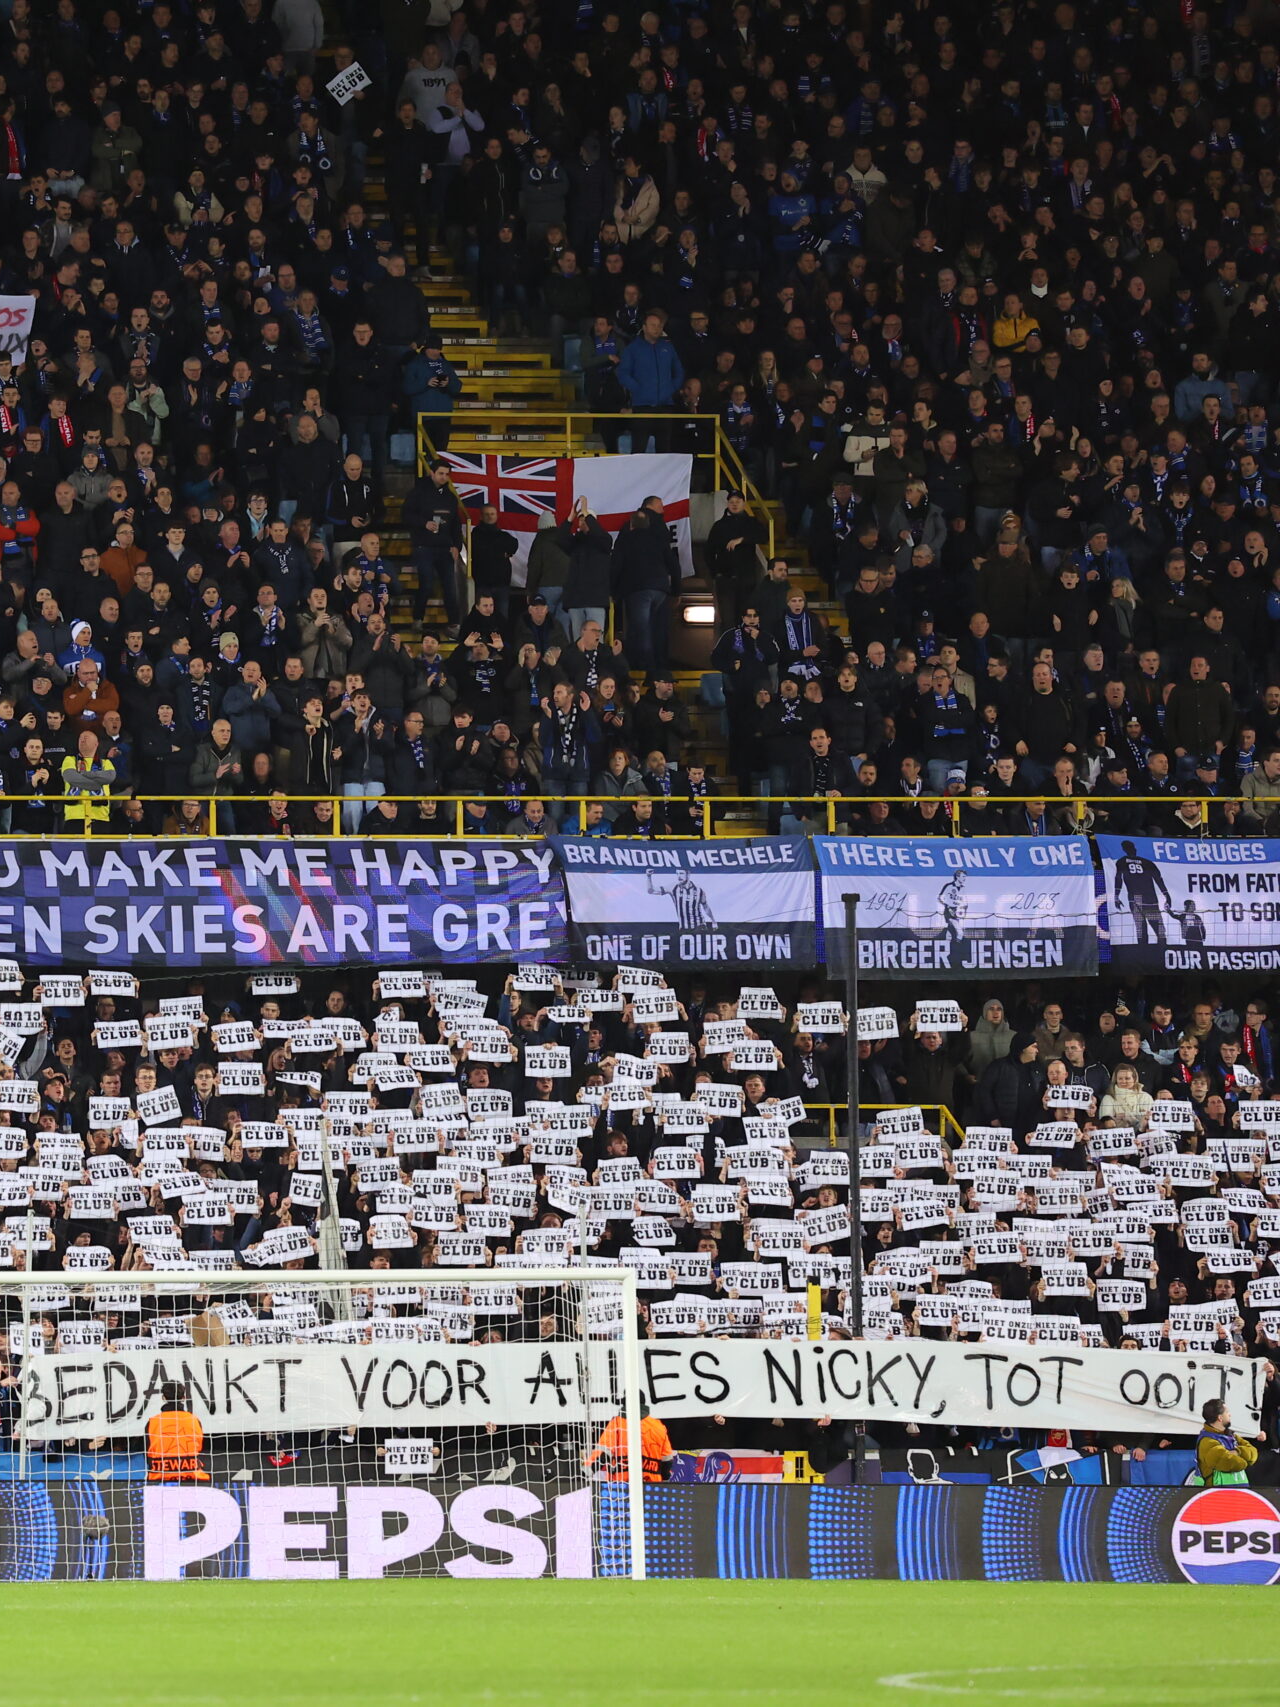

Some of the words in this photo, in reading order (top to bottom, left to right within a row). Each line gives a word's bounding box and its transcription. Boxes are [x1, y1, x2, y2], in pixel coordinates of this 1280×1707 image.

[331, 80, 344, 92] NIET
[336, 74, 364, 98] CLUB
[563, 844, 682, 867] BRANDON
[687, 844, 795, 867] MECHELE
[823, 840, 935, 868] THERE'S
[943, 848, 1017, 868] ONLY
[1029, 843, 1085, 866] ONE
[1153, 842, 1179, 861] FC
[1184, 843, 1266, 862] BRUGES
[47, 846, 219, 888] MAKE
[239, 848, 331, 887] ME
[351, 848, 554, 887] HAPPY
[1128, 863, 1144, 874] 99
[1187, 874, 1240, 893] FROM
[1219, 902, 1243, 922] TO
[83, 904, 267, 953] SKIES
[286, 903, 411, 952] ARE
[586, 934, 633, 961] ONE
[641, 934, 670, 961] OF
[679, 934, 727, 960] OUR
[736, 934, 791, 960] OWN
[858, 940, 952, 969] BIRGER
[962, 939, 1063, 969] JENSEN
[1165, 950, 1202, 970] OUR
[222, 1076, 259, 1086] CLUB
[471, 1102, 509, 1112] CLUB
[899, 1149, 938, 1160] CLUB
[1101, 1294, 1141, 1303] CLUB
[1173, 1321, 1214, 1331] CLUB
[341, 1357, 490, 1412] VOOR
[524, 1348, 730, 1407] ALLES
[965, 1354, 1083, 1410] TOT
[389, 1454, 429, 1464] CLUB
[144, 1485, 592, 1580] PEPSI
